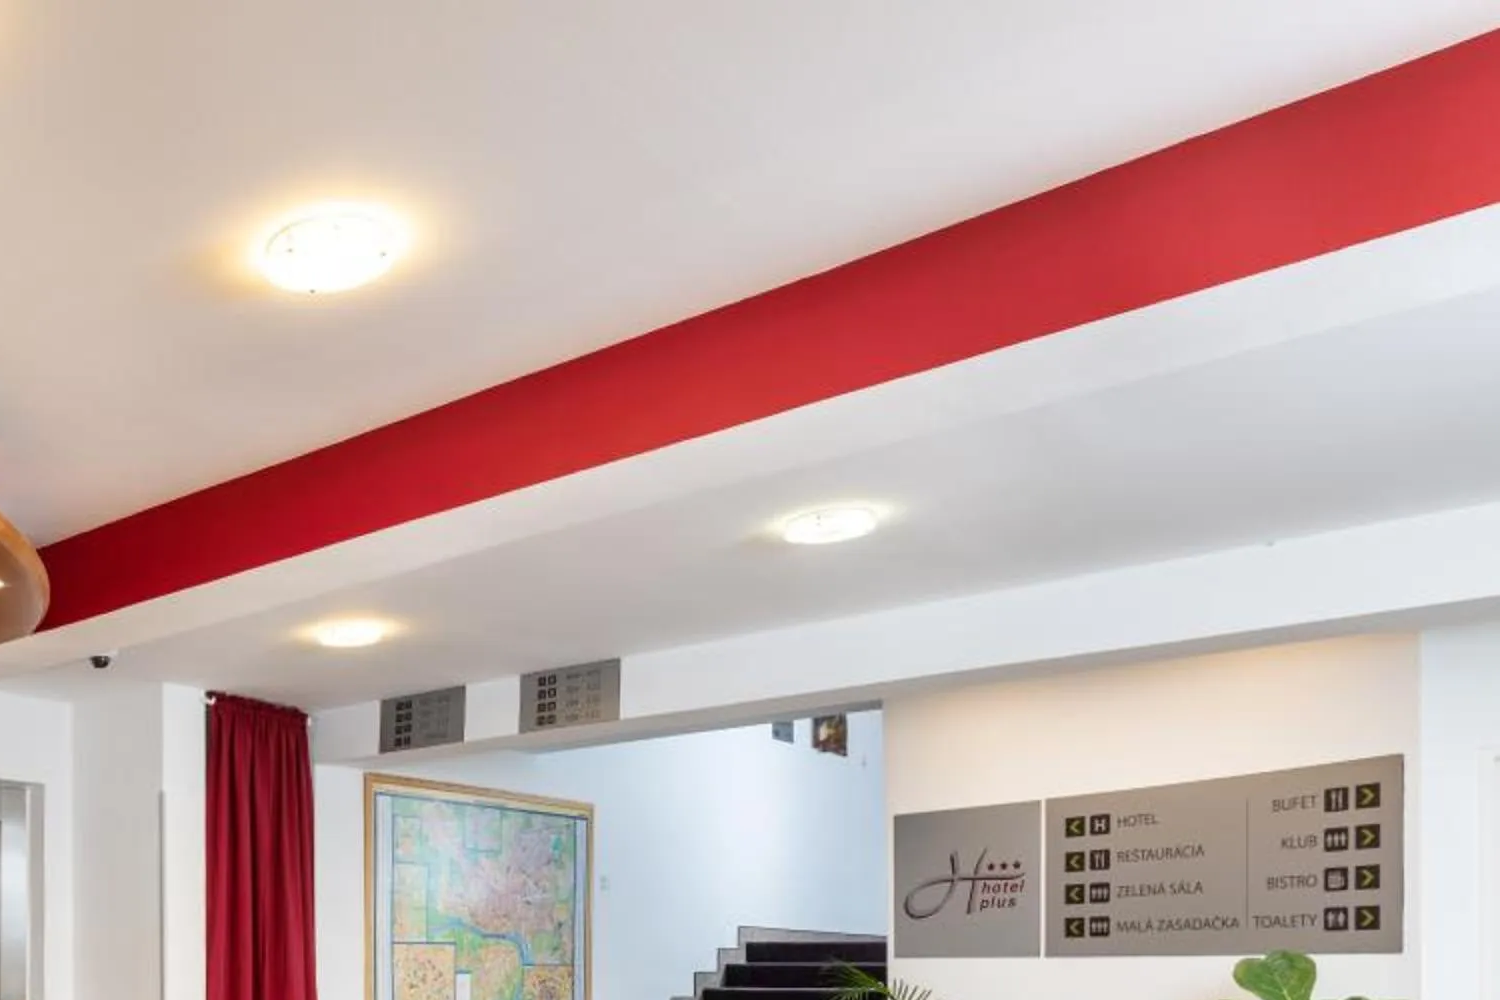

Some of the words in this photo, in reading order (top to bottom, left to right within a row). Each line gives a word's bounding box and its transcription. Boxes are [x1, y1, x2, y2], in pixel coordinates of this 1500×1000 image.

[1271, 794, 1317, 812] BUFET
[1116, 813, 1160, 828] HOTEL
[1280, 834, 1318, 850] KLUB
[981, 879, 1026, 895] hotel
[1266, 874, 1318, 891] BISTRO
[979, 896, 1017, 912] plus
[1251, 912, 1318, 930] TOALETY
